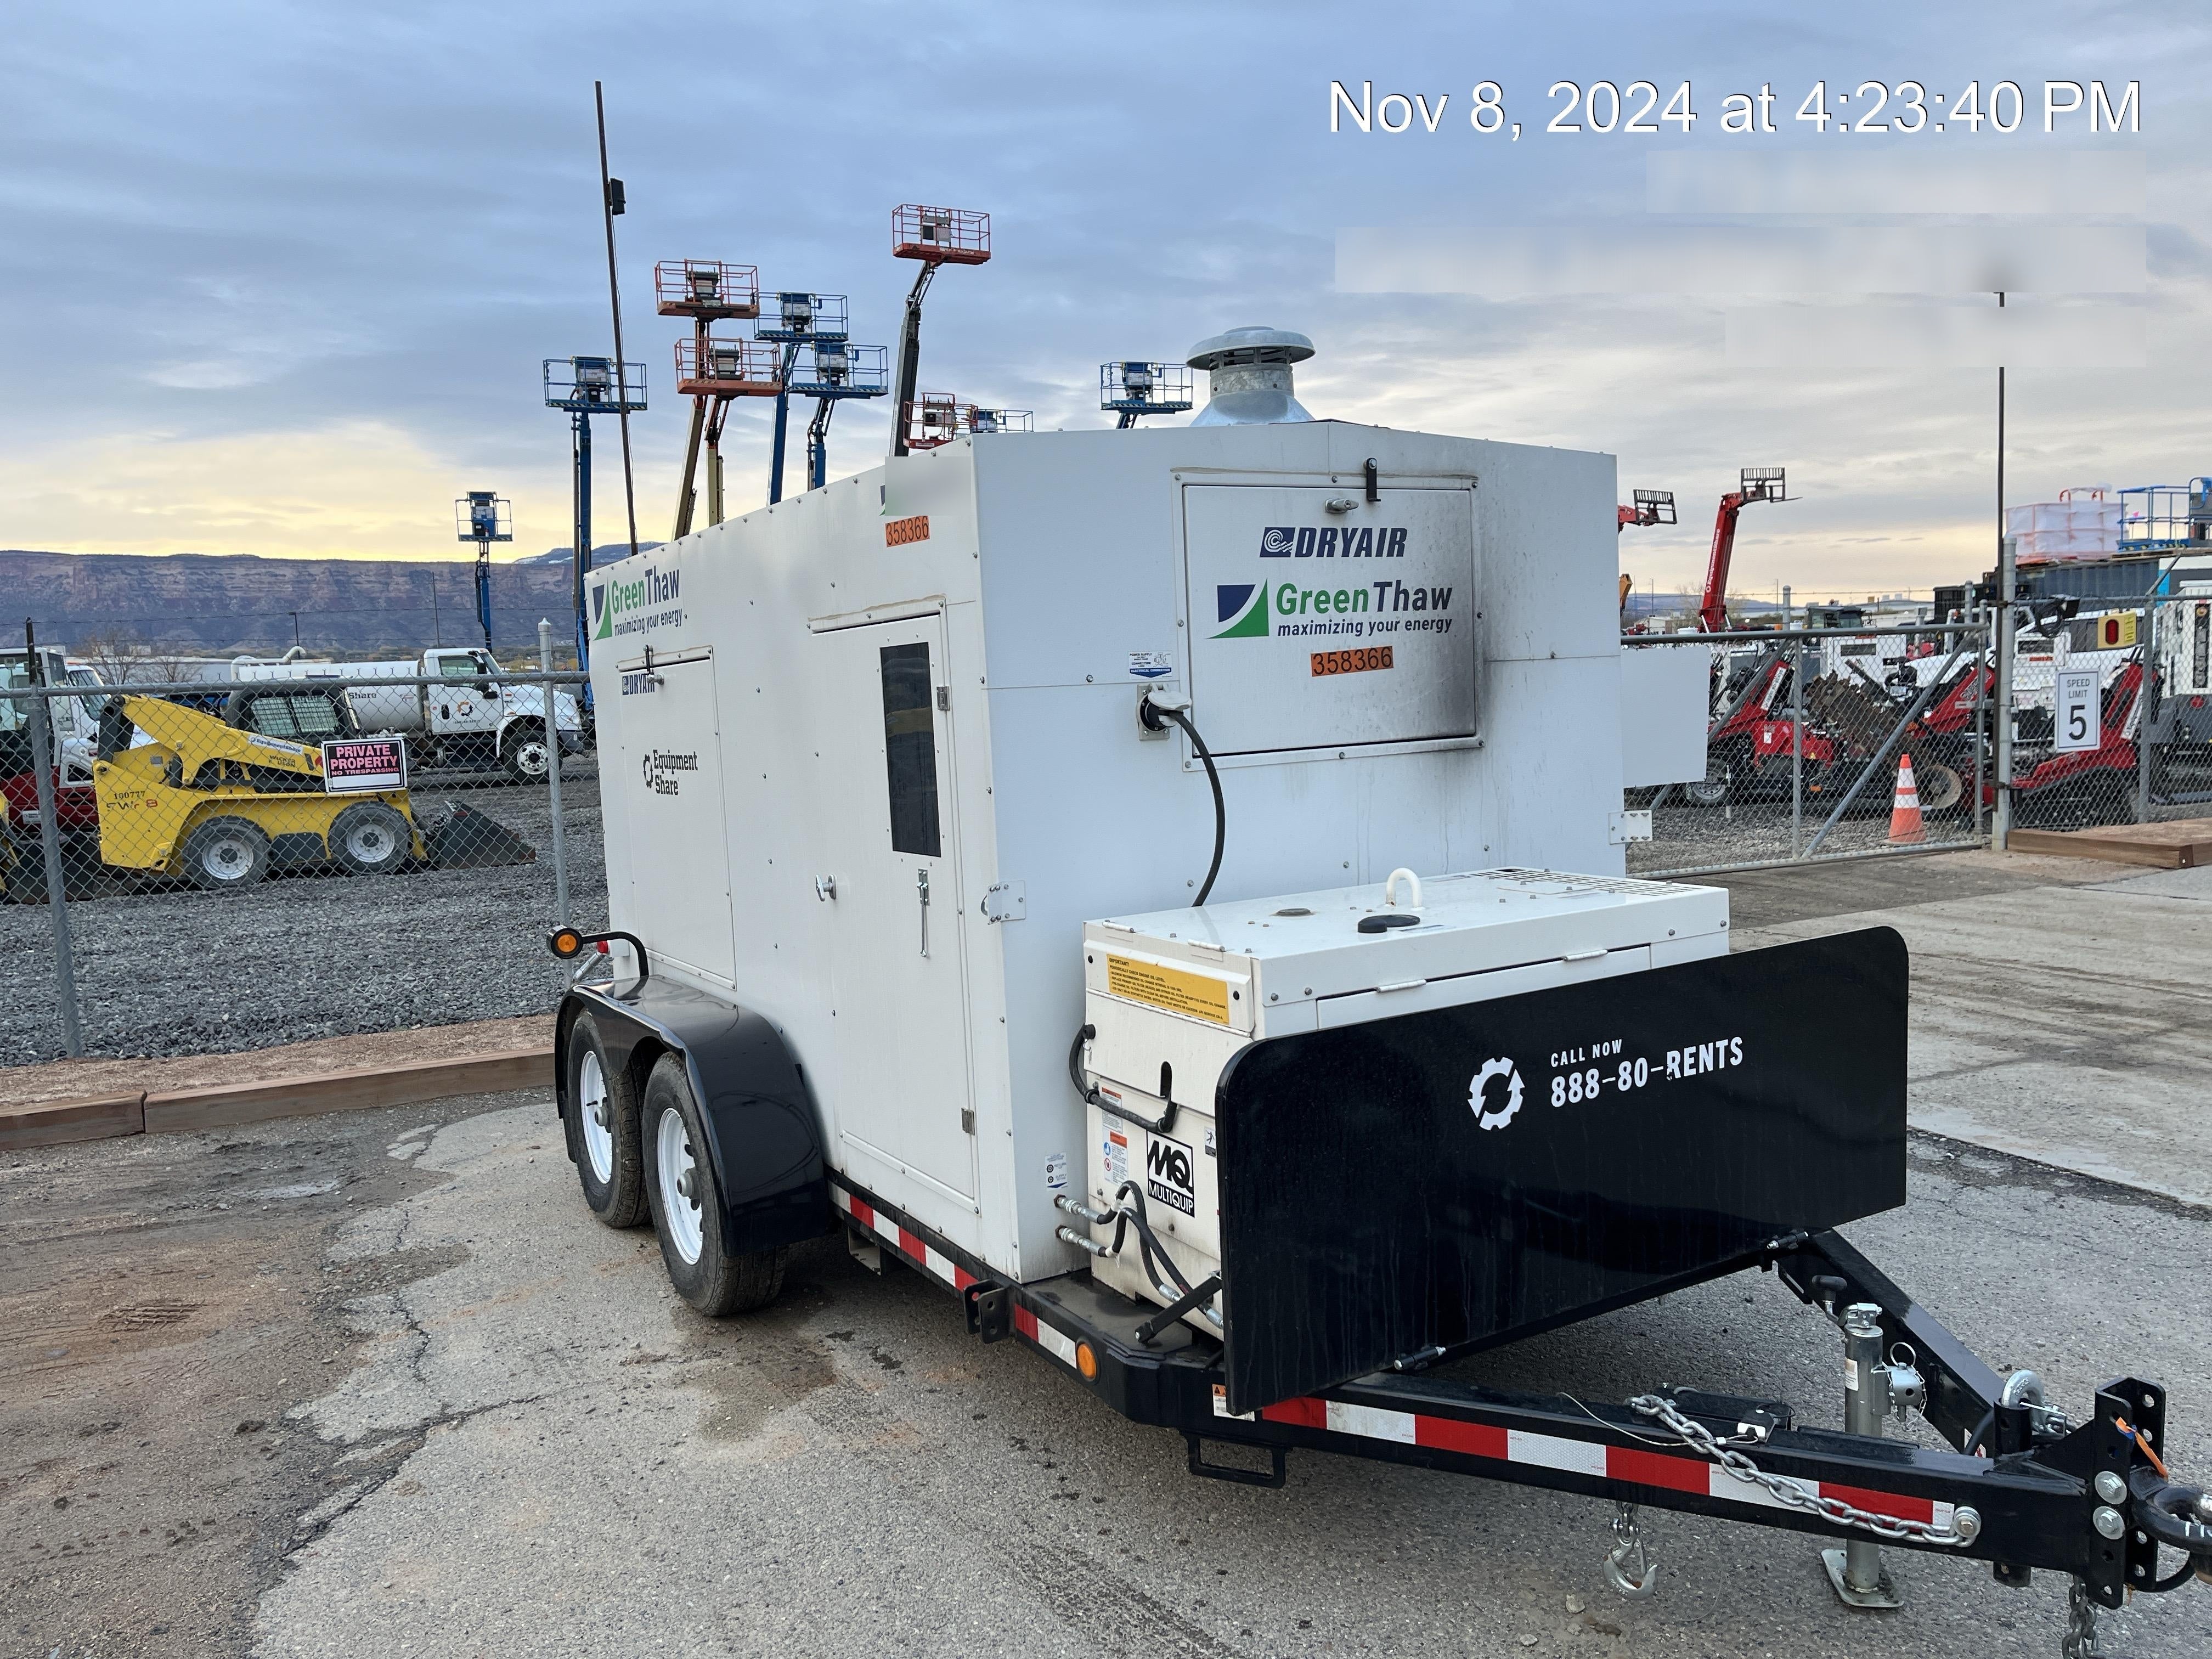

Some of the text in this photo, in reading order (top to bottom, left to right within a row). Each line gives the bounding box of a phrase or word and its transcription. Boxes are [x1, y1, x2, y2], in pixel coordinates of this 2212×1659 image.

[886, 516, 928, 545] 358366
[1295, 527, 1408, 557] DRYAIR
[612, 565, 680, 614] GreenThaw
[1277, 580, 1453, 616] GreenThaw
[614, 608, 682, 636] maximizing your energy
[1278, 617, 1453, 637] maximizing your energy
[1312, 646, 1393, 675] 358366
[2067, 679, 2090, 687] SPEED
[2068, 690, 2088, 698] LIMIT
[2069, 704, 2087, 740] 5
[330, 755, 399, 770] PROPERTY
[336, 744, 391, 758] PRIVATE
[653, 749, 698, 774] Equipment
[654, 774, 679, 795] Share
[1550, 1039, 1623, 1068] CALL NOW
[1550, 1036, 1743, 1108] 888-80-RENTS
[1148, 1140, 1193, 1194] MQ
[1149, 1180, 1193, 1214] MULTIQUIP
